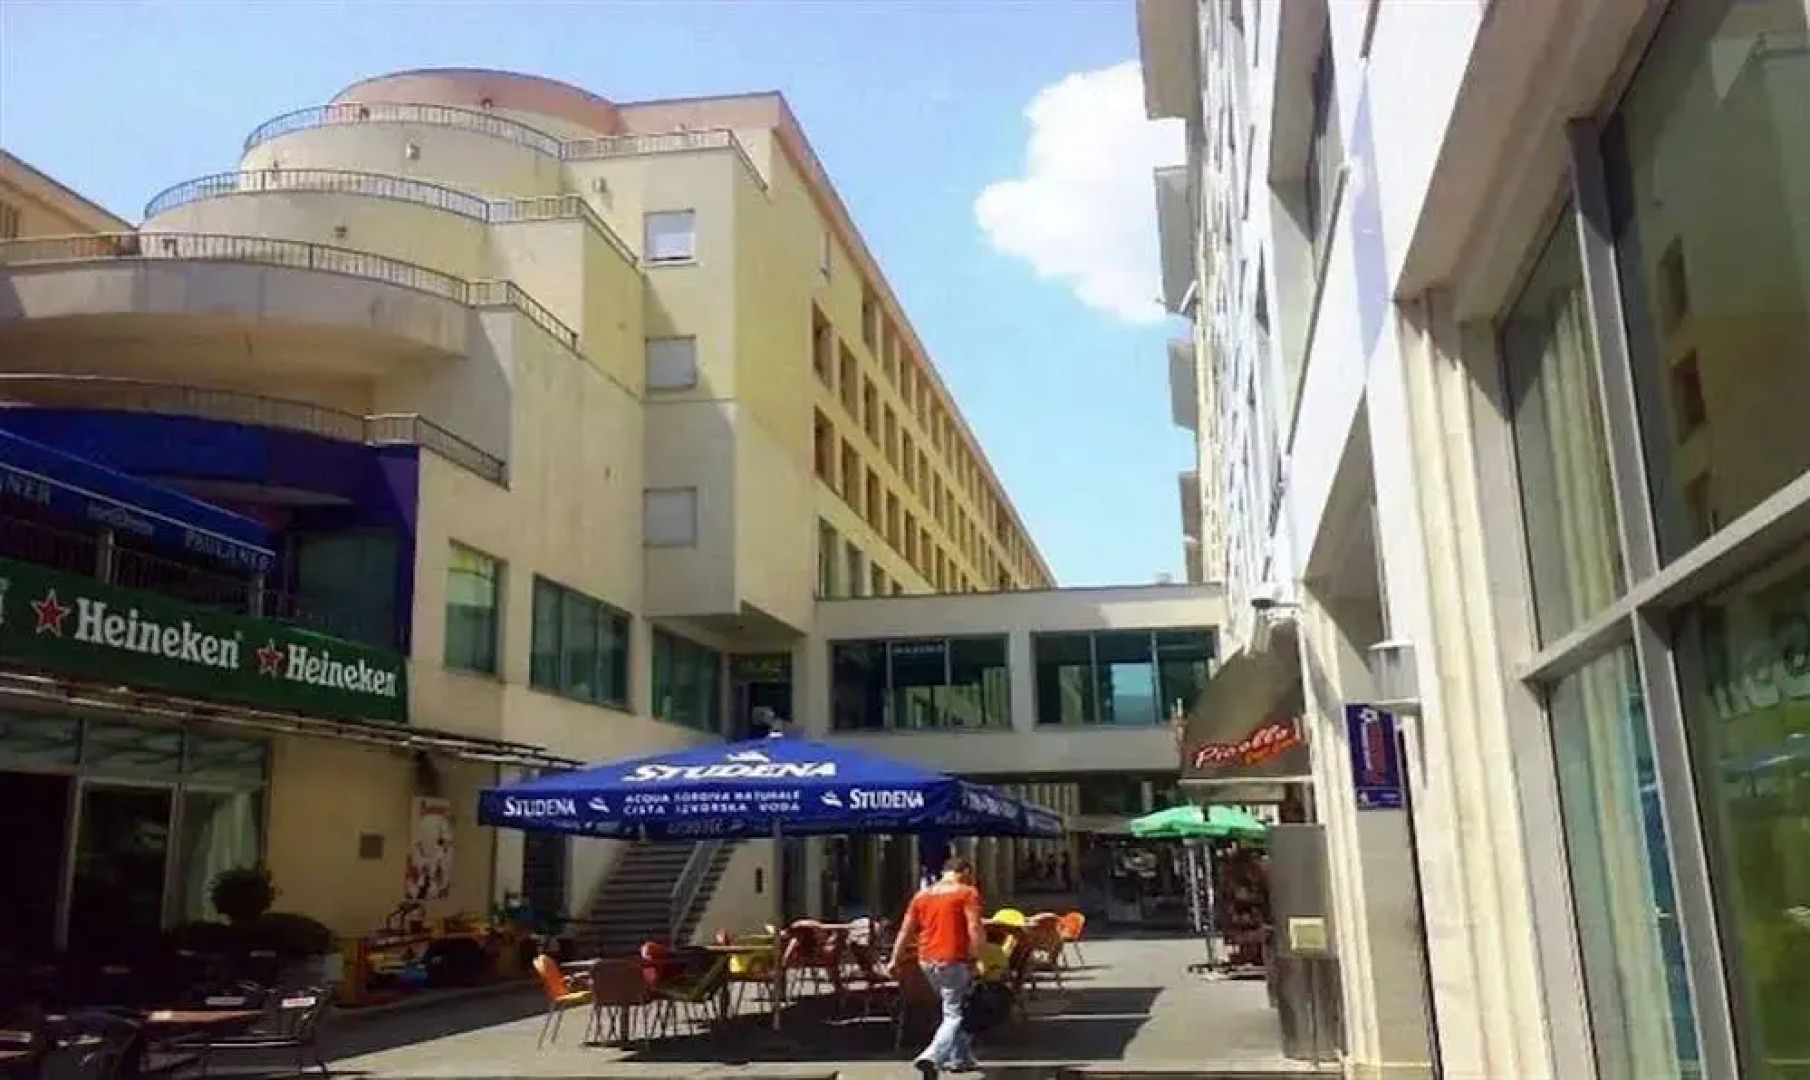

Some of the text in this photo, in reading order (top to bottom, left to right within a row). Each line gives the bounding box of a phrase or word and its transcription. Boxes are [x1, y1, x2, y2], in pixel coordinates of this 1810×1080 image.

[74, 597, 240, 670] Heineken
[287, 643, 398, 698] Heineken
[622, 761, 838, 782] STUDENA
[503, 796, 577, 818] STUDENA
[757, 801, 801, 813] VODA
[849, 787, 926, 810] STUDENA
